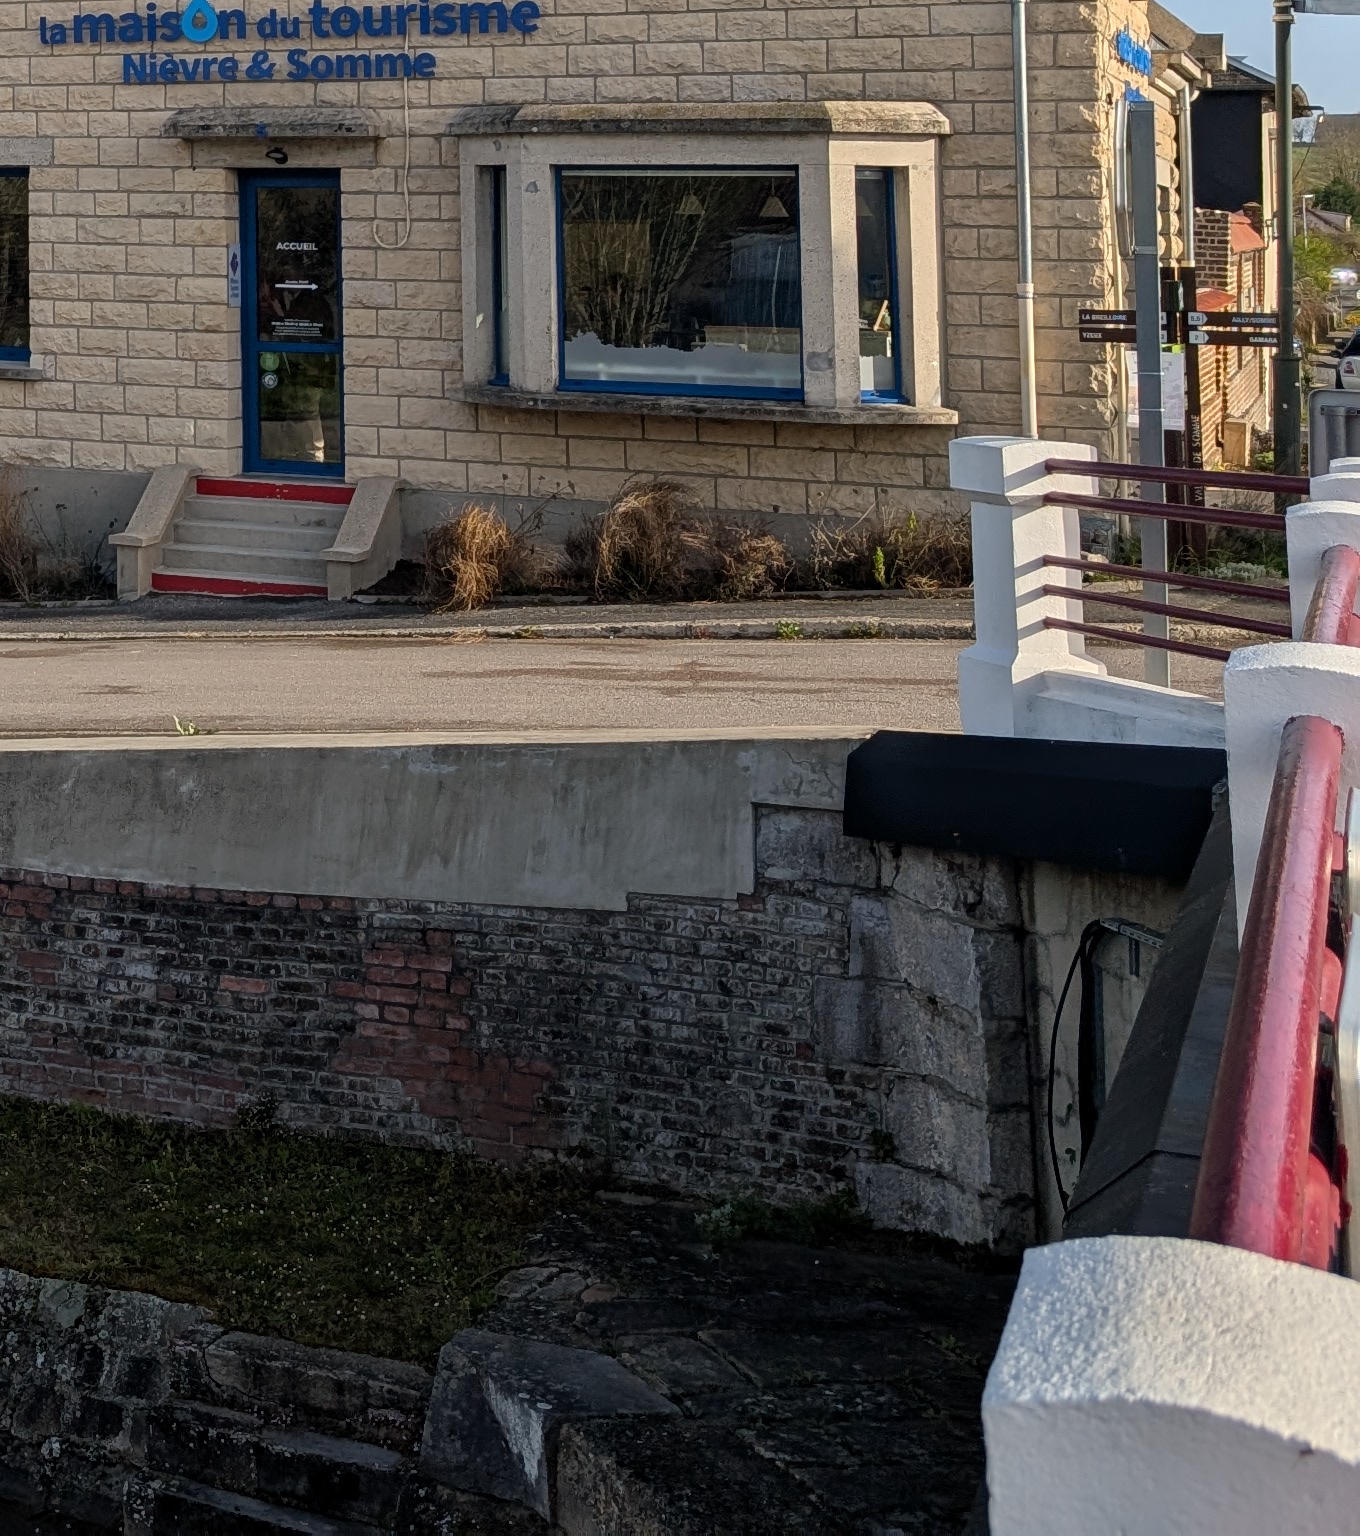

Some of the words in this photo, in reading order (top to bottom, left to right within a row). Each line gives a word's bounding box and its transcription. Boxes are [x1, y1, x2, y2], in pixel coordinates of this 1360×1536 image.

[39, 16, 68, 45] la
[257, 8, 301, 40] du
[122, 52, 239, 85] Nièvre
[245, 52, 277, 81] &
[286, 48, 437, 82] Somme
[276, 242, 318, 250] ACCUEIL
[1192, 451, 1202, 464] DE
